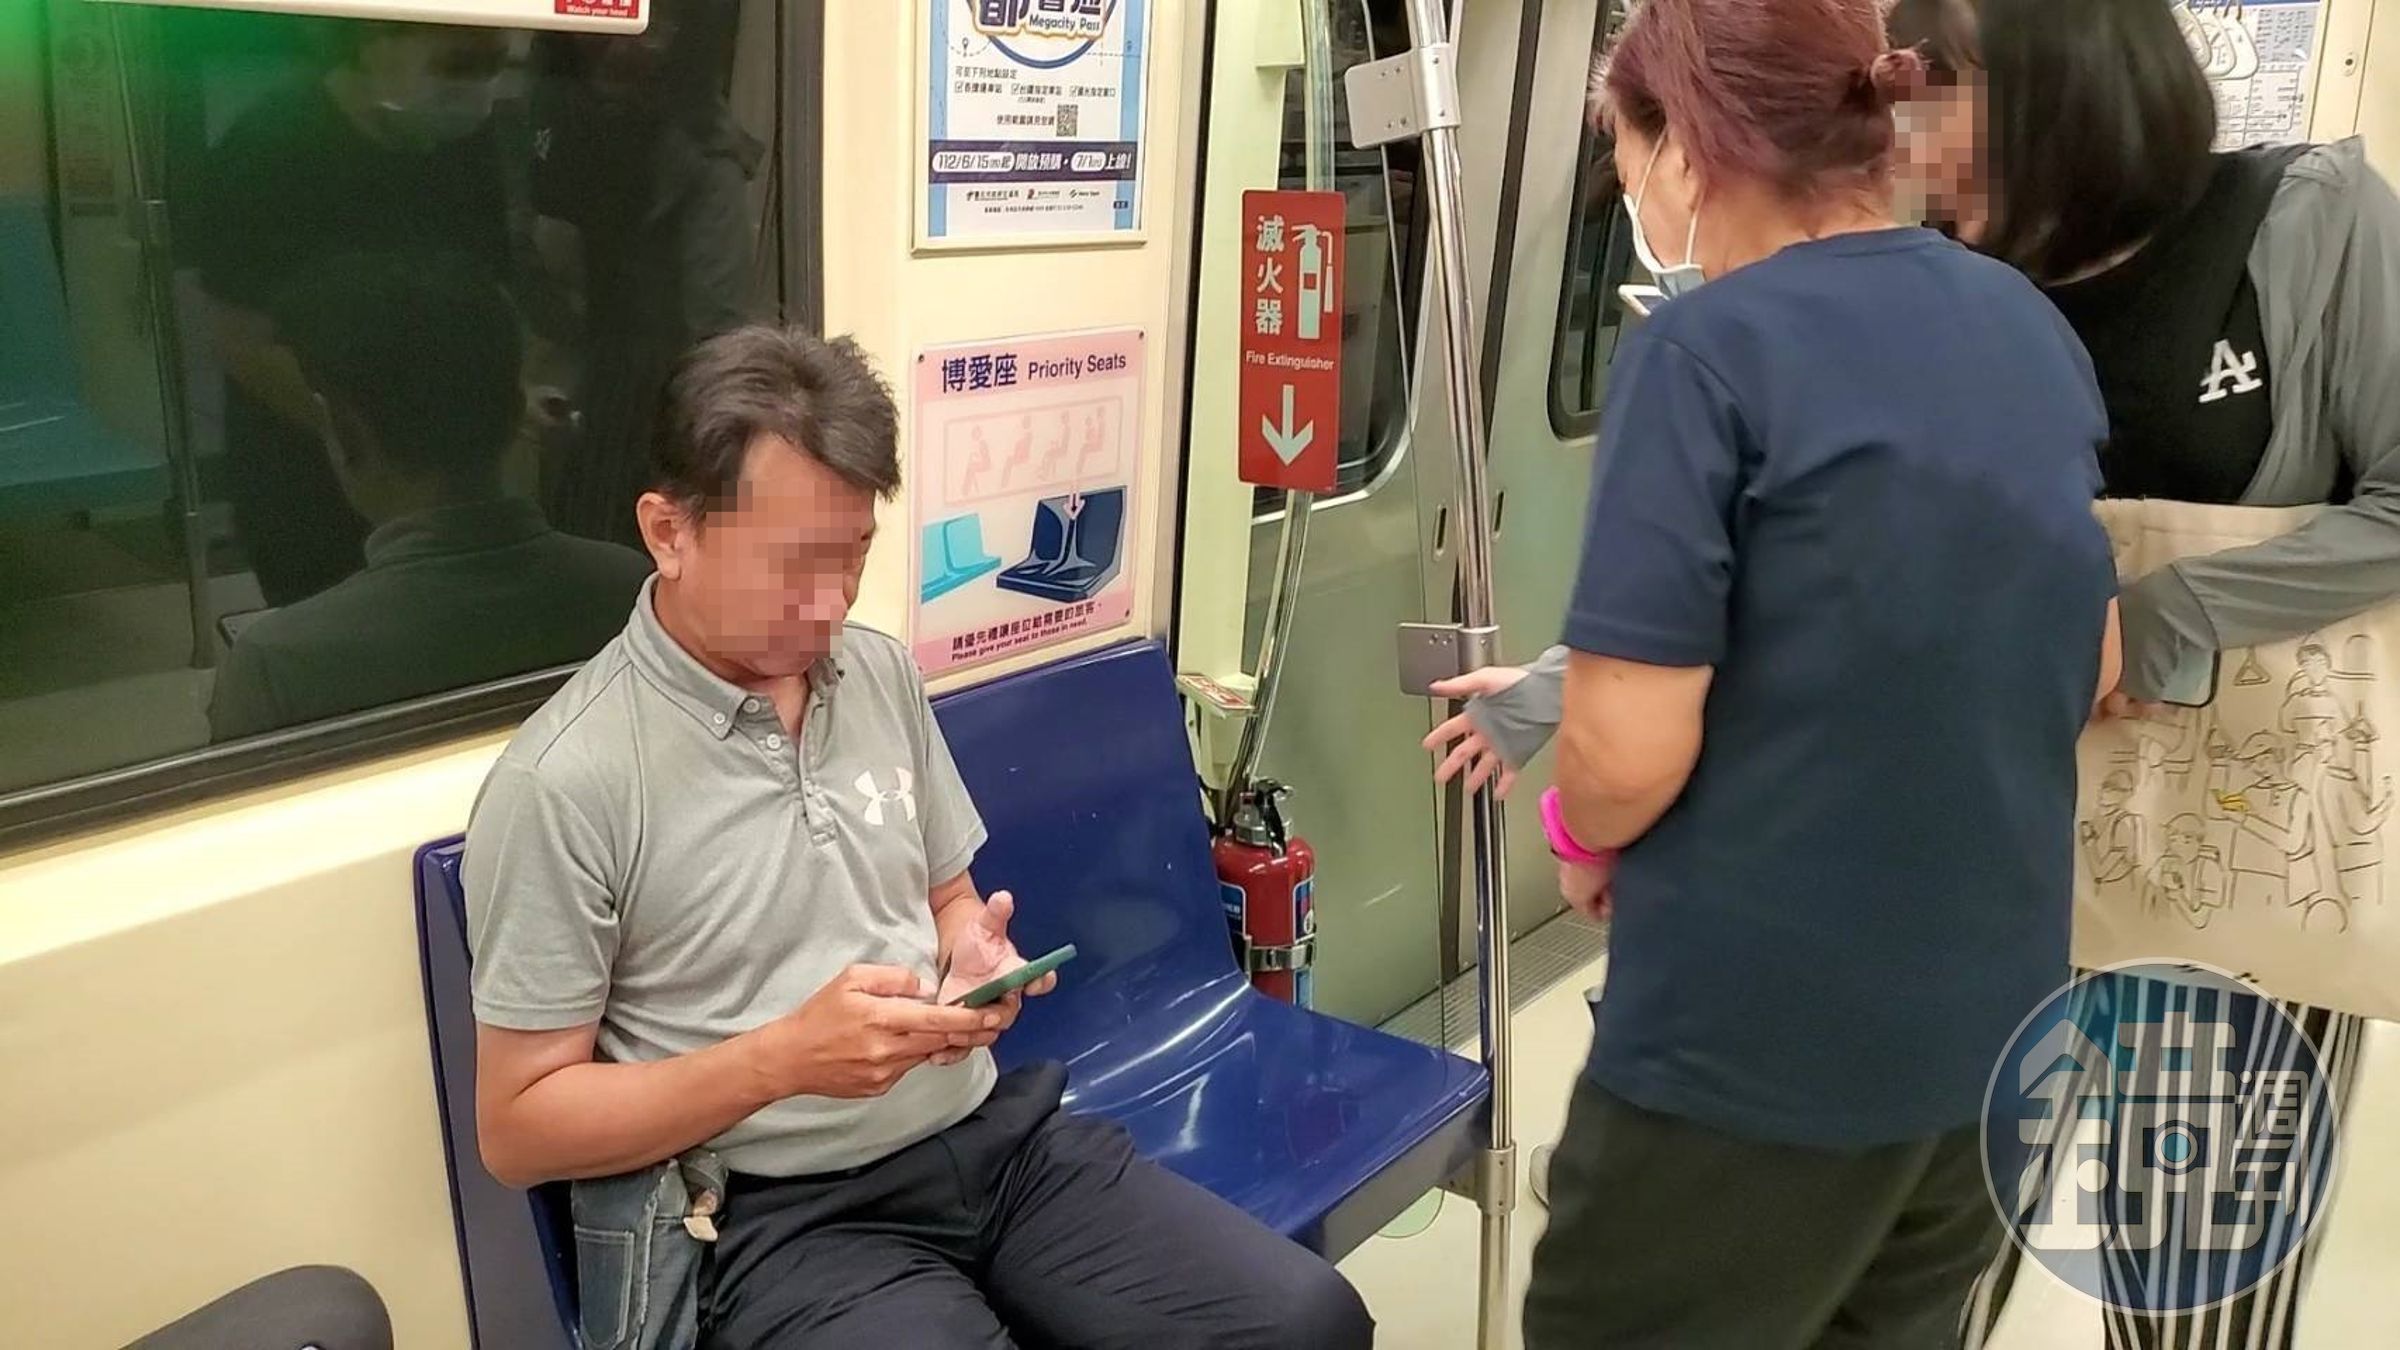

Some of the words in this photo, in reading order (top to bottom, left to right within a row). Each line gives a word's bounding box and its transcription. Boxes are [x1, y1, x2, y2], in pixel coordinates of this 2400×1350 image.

[1029, 14, 1075, 31] Megacity
[1079, 18, 1100, 31] Pass
[1256, 214, 1285, 335] 滅火器
[942, 352, 1018, 394] 博愛座
[1028, 356, 1082, 381] Priority
[1088, 352, 1126, 373] Seats
[1246, 351, 1265, 365] Fire
[1267, 352, 1334, 370] Extinguisher
[952, 650, 977, 662] Please
[979, 645, 995, 657] give
[996, 639, 1014, 651] your
[1014, 633, 1030, 644] seat
[1031, 631, 1039, 640] to
[1040, 626, 1059, 638] those
[1061, 622, 1069, 632] in
